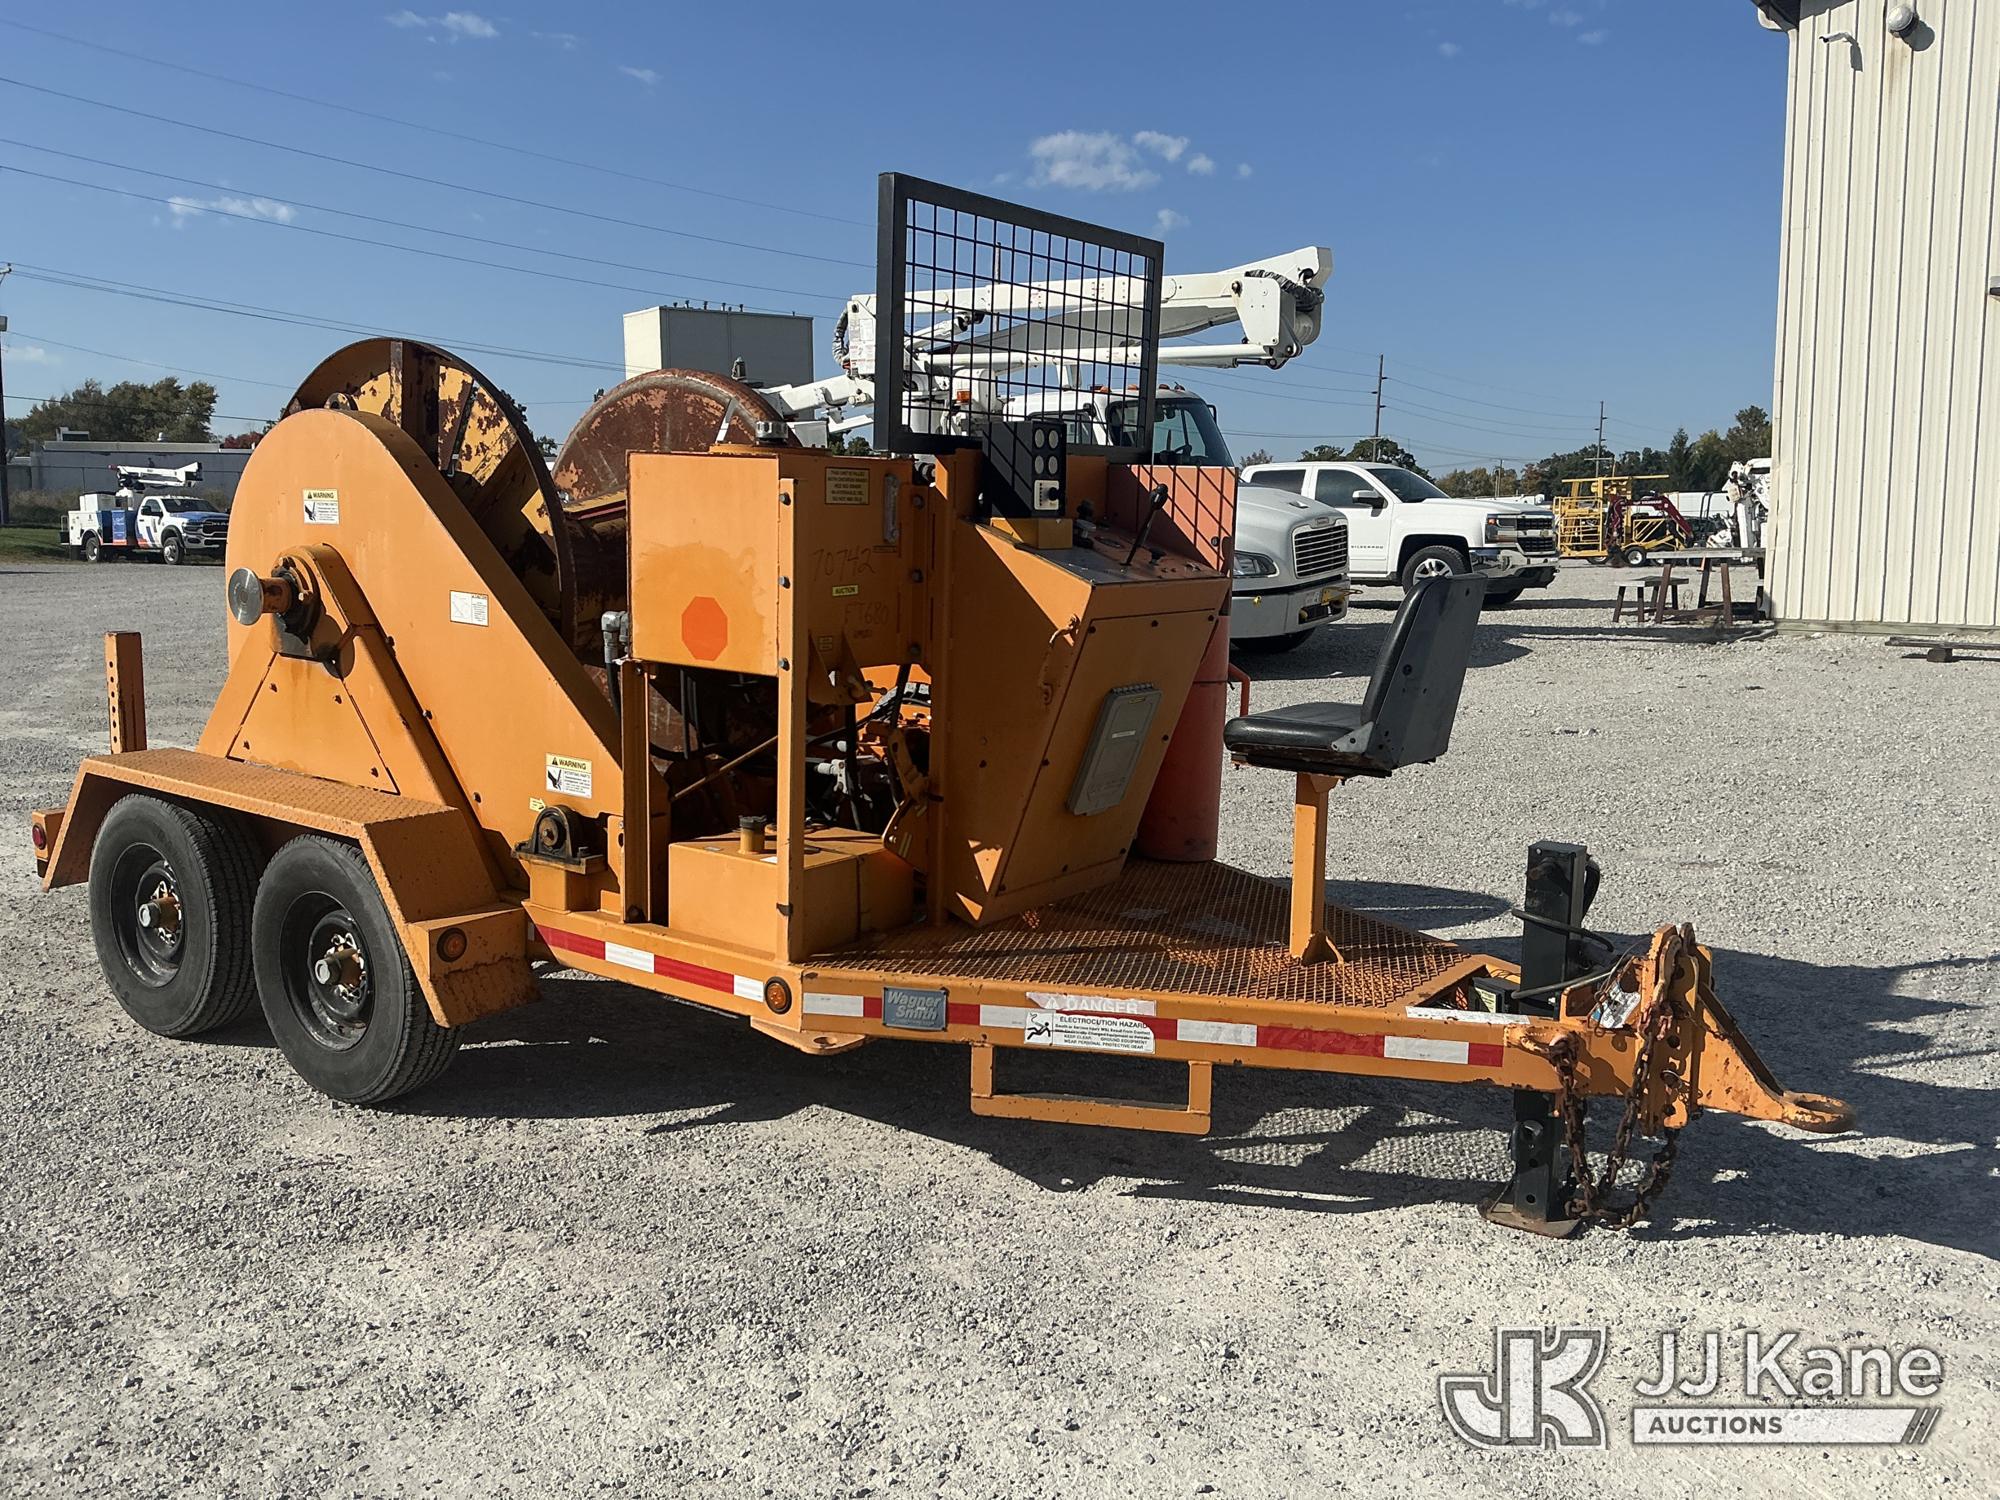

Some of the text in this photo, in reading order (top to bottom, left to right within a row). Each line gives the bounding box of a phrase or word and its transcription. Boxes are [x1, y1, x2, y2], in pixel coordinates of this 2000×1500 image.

[809, 545, 876, 581] 70742
[559, 759, 586, 770] WARNING
[887, 991, 942, 1008] Wagner
[1066, 999, 1138, 1013] DANGER
[895, 1005, 938, 1020] Smith
[1060, 1016, 1147, 1029] ELECTROCUTION HAZARD
